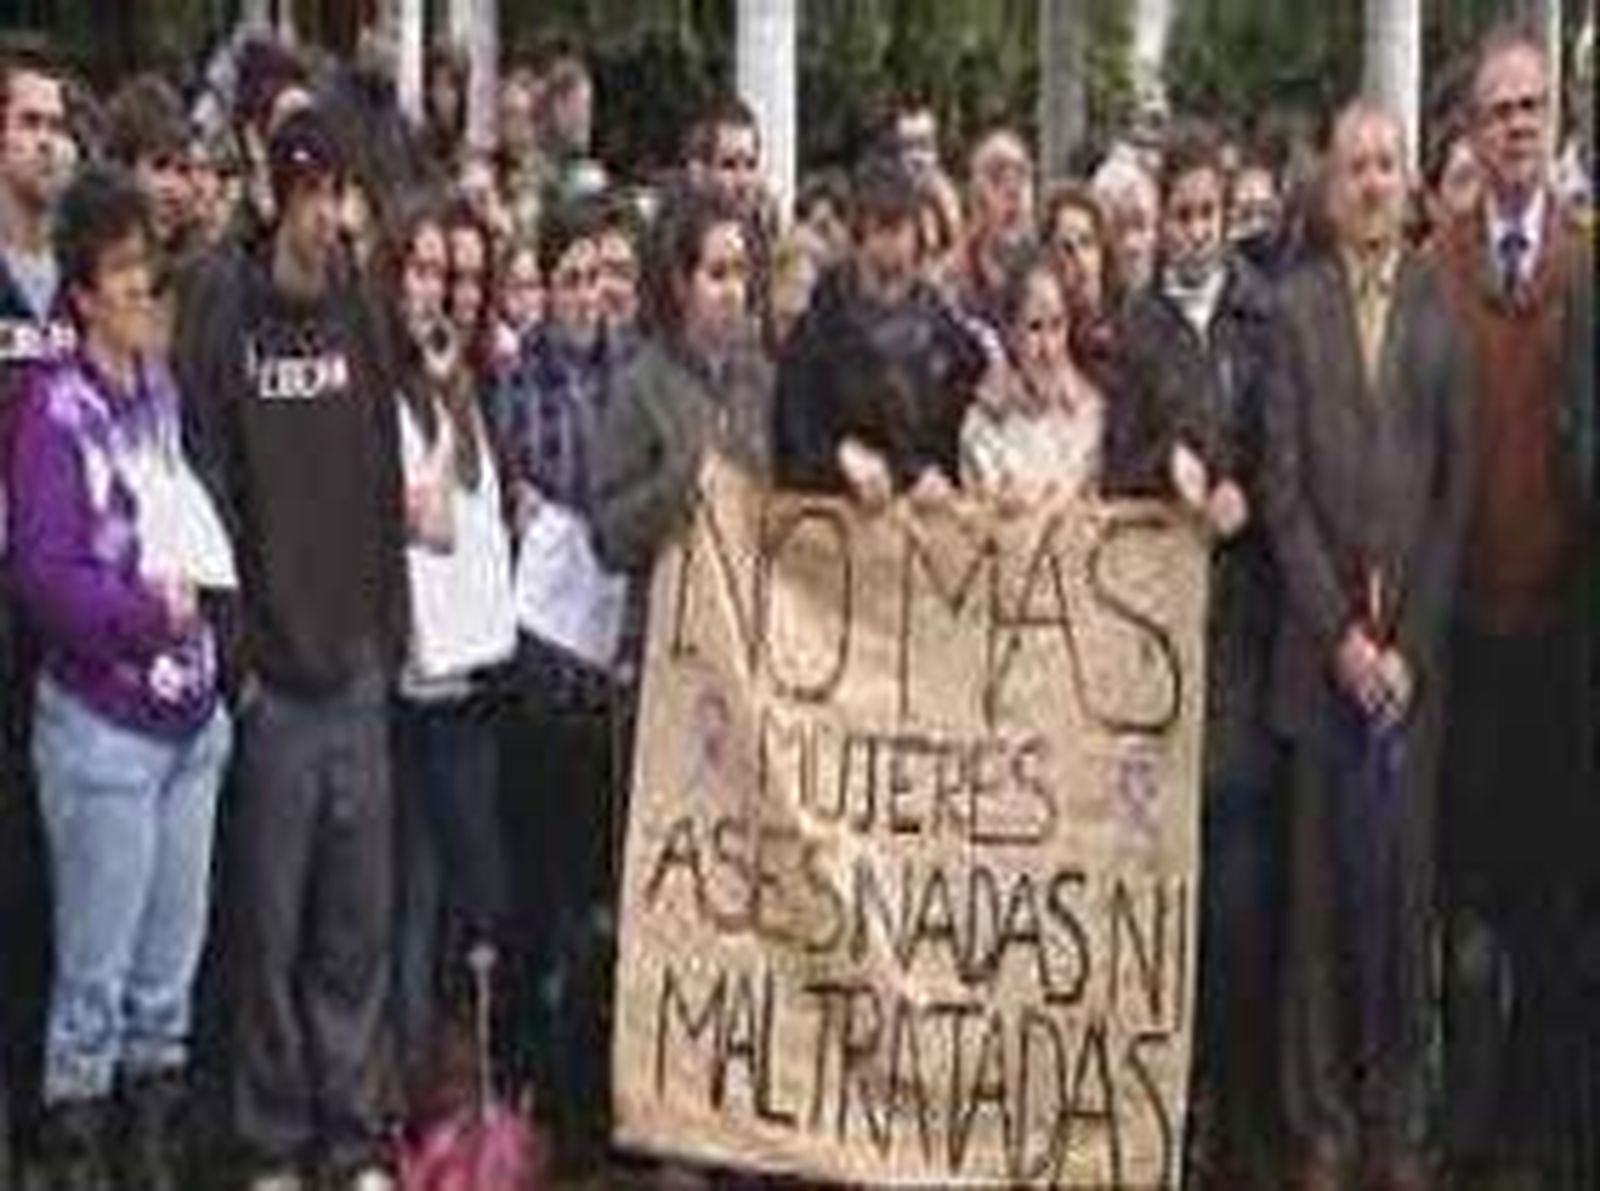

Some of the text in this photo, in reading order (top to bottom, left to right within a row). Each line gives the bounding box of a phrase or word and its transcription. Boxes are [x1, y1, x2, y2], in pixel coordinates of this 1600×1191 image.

[670, 495, 1181, 735] NO MAS
[757, 704, 1058, 844] MUJERES
[1108, 872, 1187, 1032] NI
